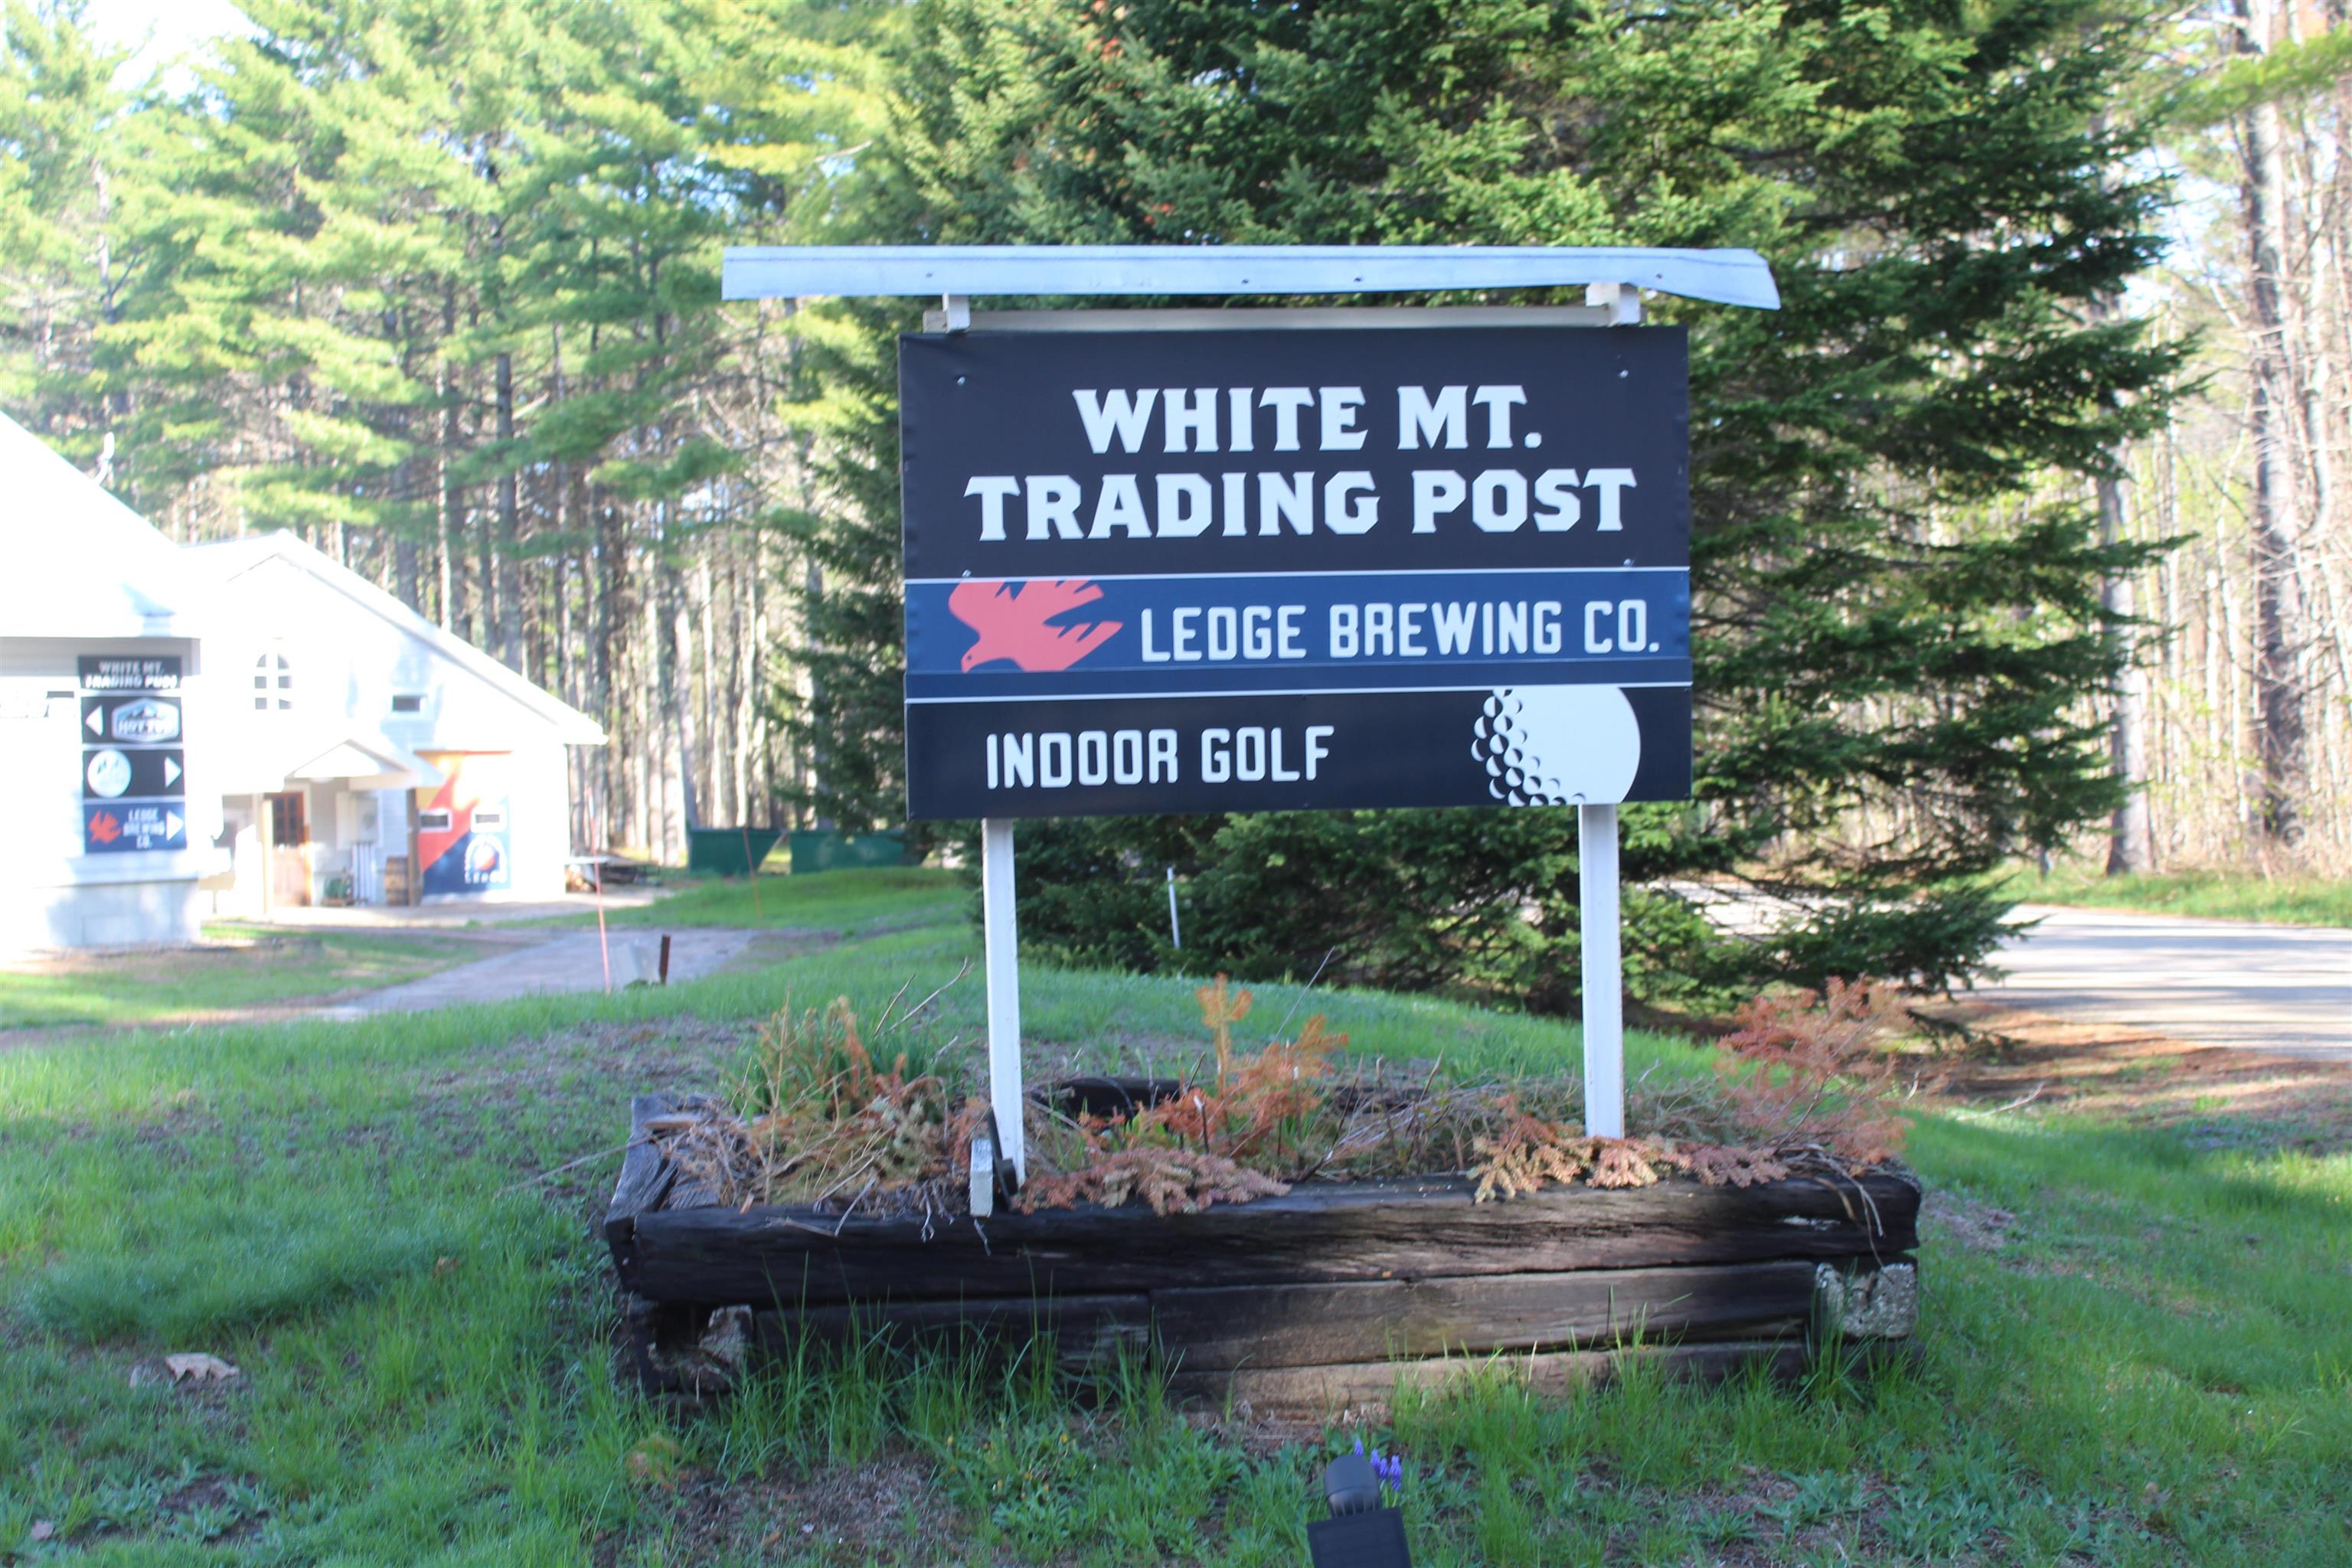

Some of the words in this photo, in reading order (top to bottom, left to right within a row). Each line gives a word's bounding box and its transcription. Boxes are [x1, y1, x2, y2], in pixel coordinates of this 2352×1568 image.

[1073, 387, 1369, 454] WHITE
[1397, 385, 1543, 449] MT.
[963, 470, 1380, 541] TRADING
[1411, 468, 1638, 534] POST
[1141, 605, 1307, 662] LEDGE
[1329, 601, 1562, 658] BREWING
[1584, 599, 1660, 654] CO.
[99, 661, 140, 674] WHITE
[986, 729, 1178, 789] INDOOR
[1201, 726, 1334, 782] GOLF
